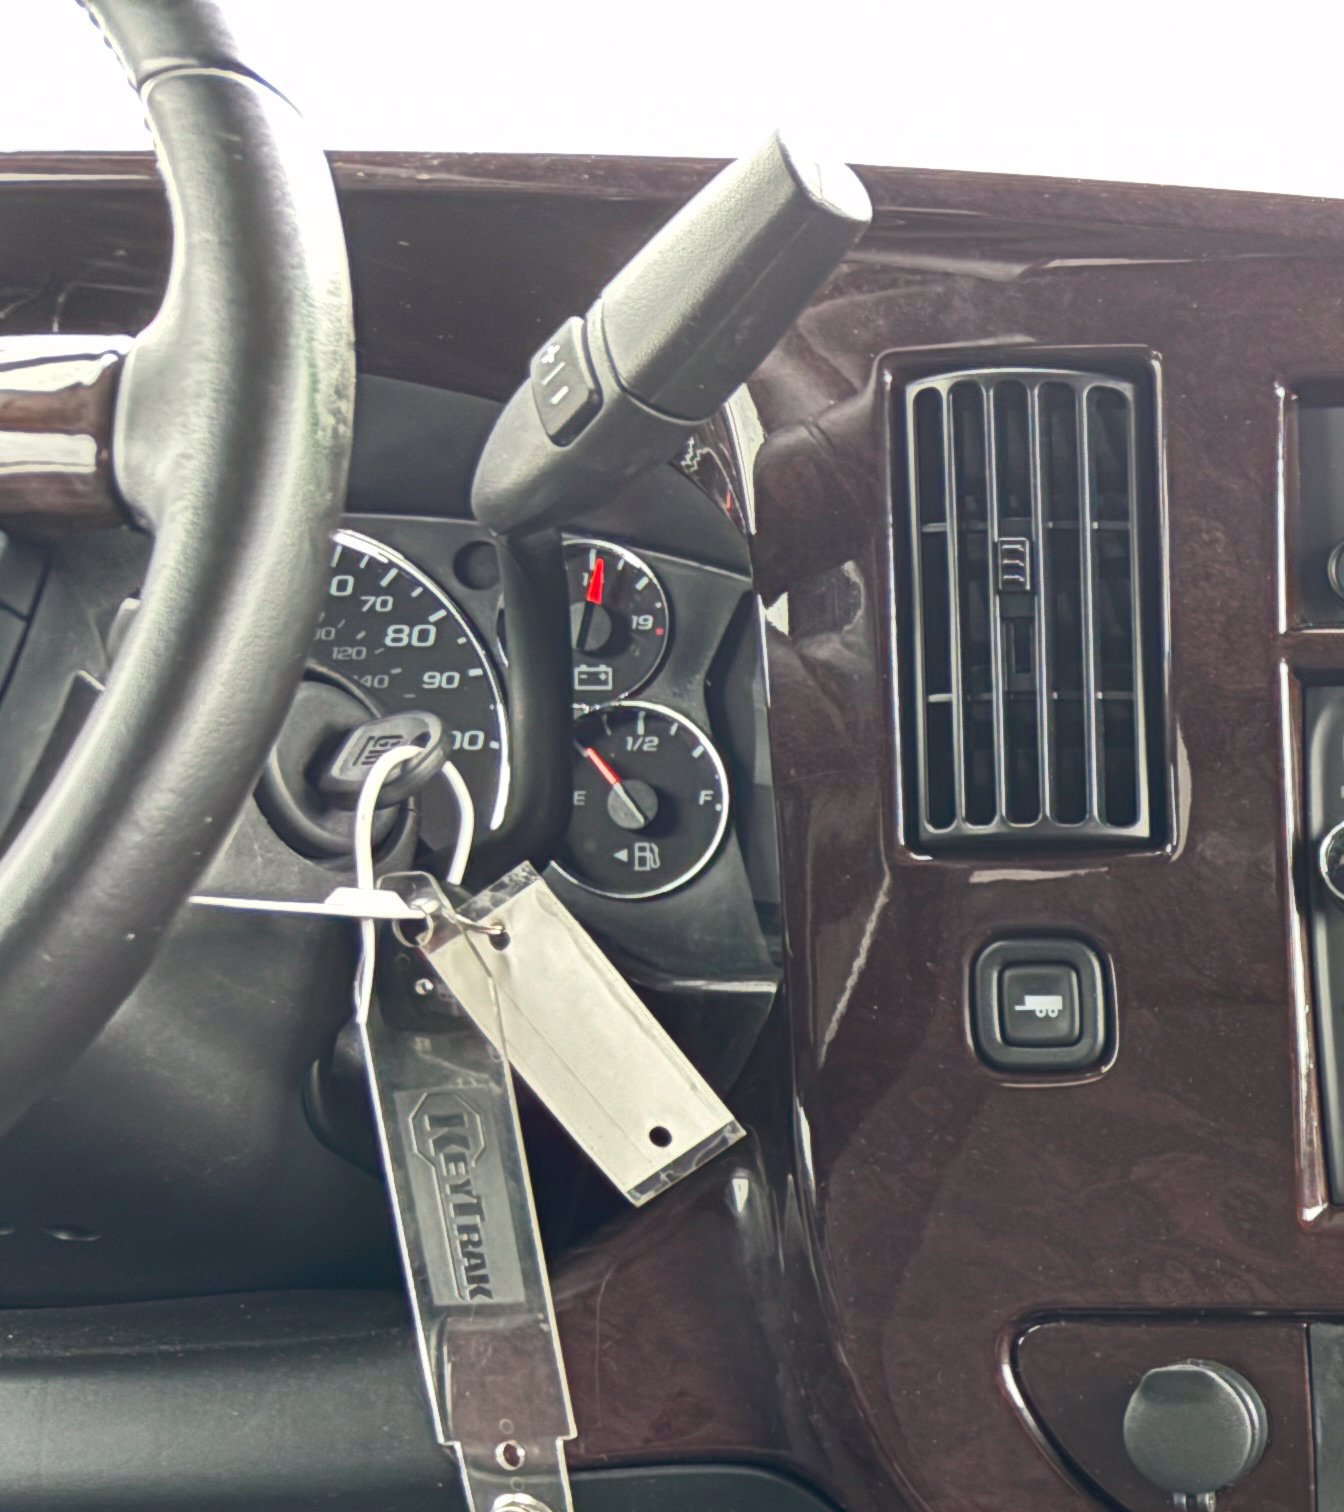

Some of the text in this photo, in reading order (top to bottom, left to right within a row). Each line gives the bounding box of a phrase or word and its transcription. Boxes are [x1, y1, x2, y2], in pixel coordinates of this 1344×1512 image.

[360, 595, 394, 612] 70
[631, 615, 654, 630] 19
[384, 624, 437, 647] 80
[332, 646, 368, 661] 120
[353, 674, 390, 689] 40
[422, 671, 461, 689] 90
[625, 736, 659, 751] 1/2
[573, 791, 587, 806] E
[699, 791, 714, 805] F
[424, 1113, 494, 1301] KEYTRAK
